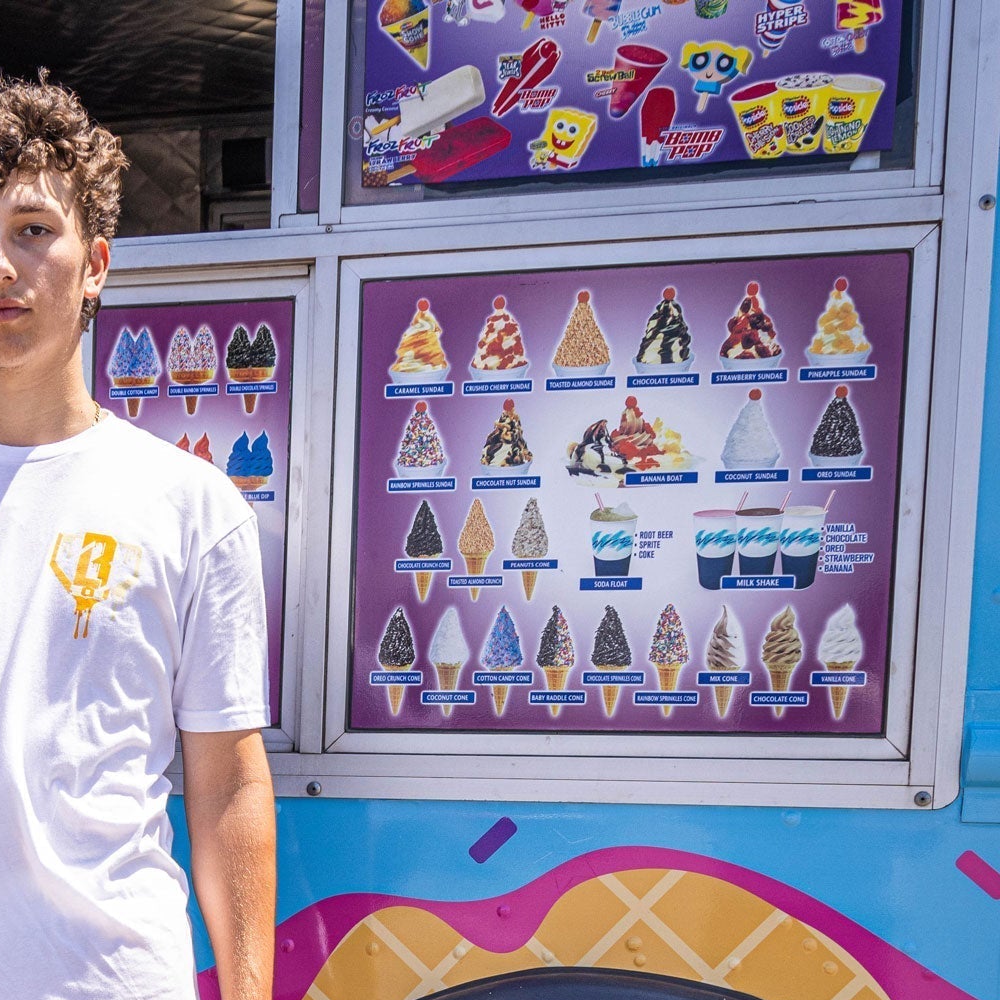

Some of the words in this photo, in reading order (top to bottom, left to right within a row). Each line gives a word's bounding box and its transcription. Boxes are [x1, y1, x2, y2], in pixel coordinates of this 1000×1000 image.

[540, 13, 565, 23] HELLO
[757, 5, 804, 23] HYPER
[540, 20, 565, 30] KITTY
[757, 12, 807, 33] STRIPE
[662, 130, 724, 147] BOMB
[667, 143, 715, 160] POP
[715, 374, 757, 382] STRAWBERRY
[757, 372, 783, 380] SUNDAE
[808, 370, 841, 378] PINEAPPLE
[841, 369, 867, 377] SUNDAE
[549, 381, 571, 389] TOASTED
[571, 380, 593, 388] ALMOND
[593, 379, 613, 387] SUNDAE
[669, 376, 694, 384] SUNDAE
[422, 386, 444, 394] SUNDAE
[465, 384, 489, 392] CRUSHED
[511, 382, 530, 390] SUNDAE
[666, 474, 683, 482] BOAT
[754, 472, 778, 480] SUNDAE
[833, 470, 856, 478] SUNDAE
[435, 480, 453, 488] SUNDAE
[517, 478, 536, 486] SUNDAE
[826, 525, 855, 533] VANILLA
[640, 531, 656, 539] ROOT
[657, 530, 673, 539] BEER
[825, 534, 866, 542] CHOCOLATE
[639, 540, 661, 549] SPRITE
[825, 544, 845, 552] OREO
[638, 550, 655, 559] COKE
[824, 554, 873, 562] STRAWBERRY
[824, 564, 853, 572] BANANA
[736, 579, 755, 587] MILK
[756, 578, 779, 586] SHAKE
